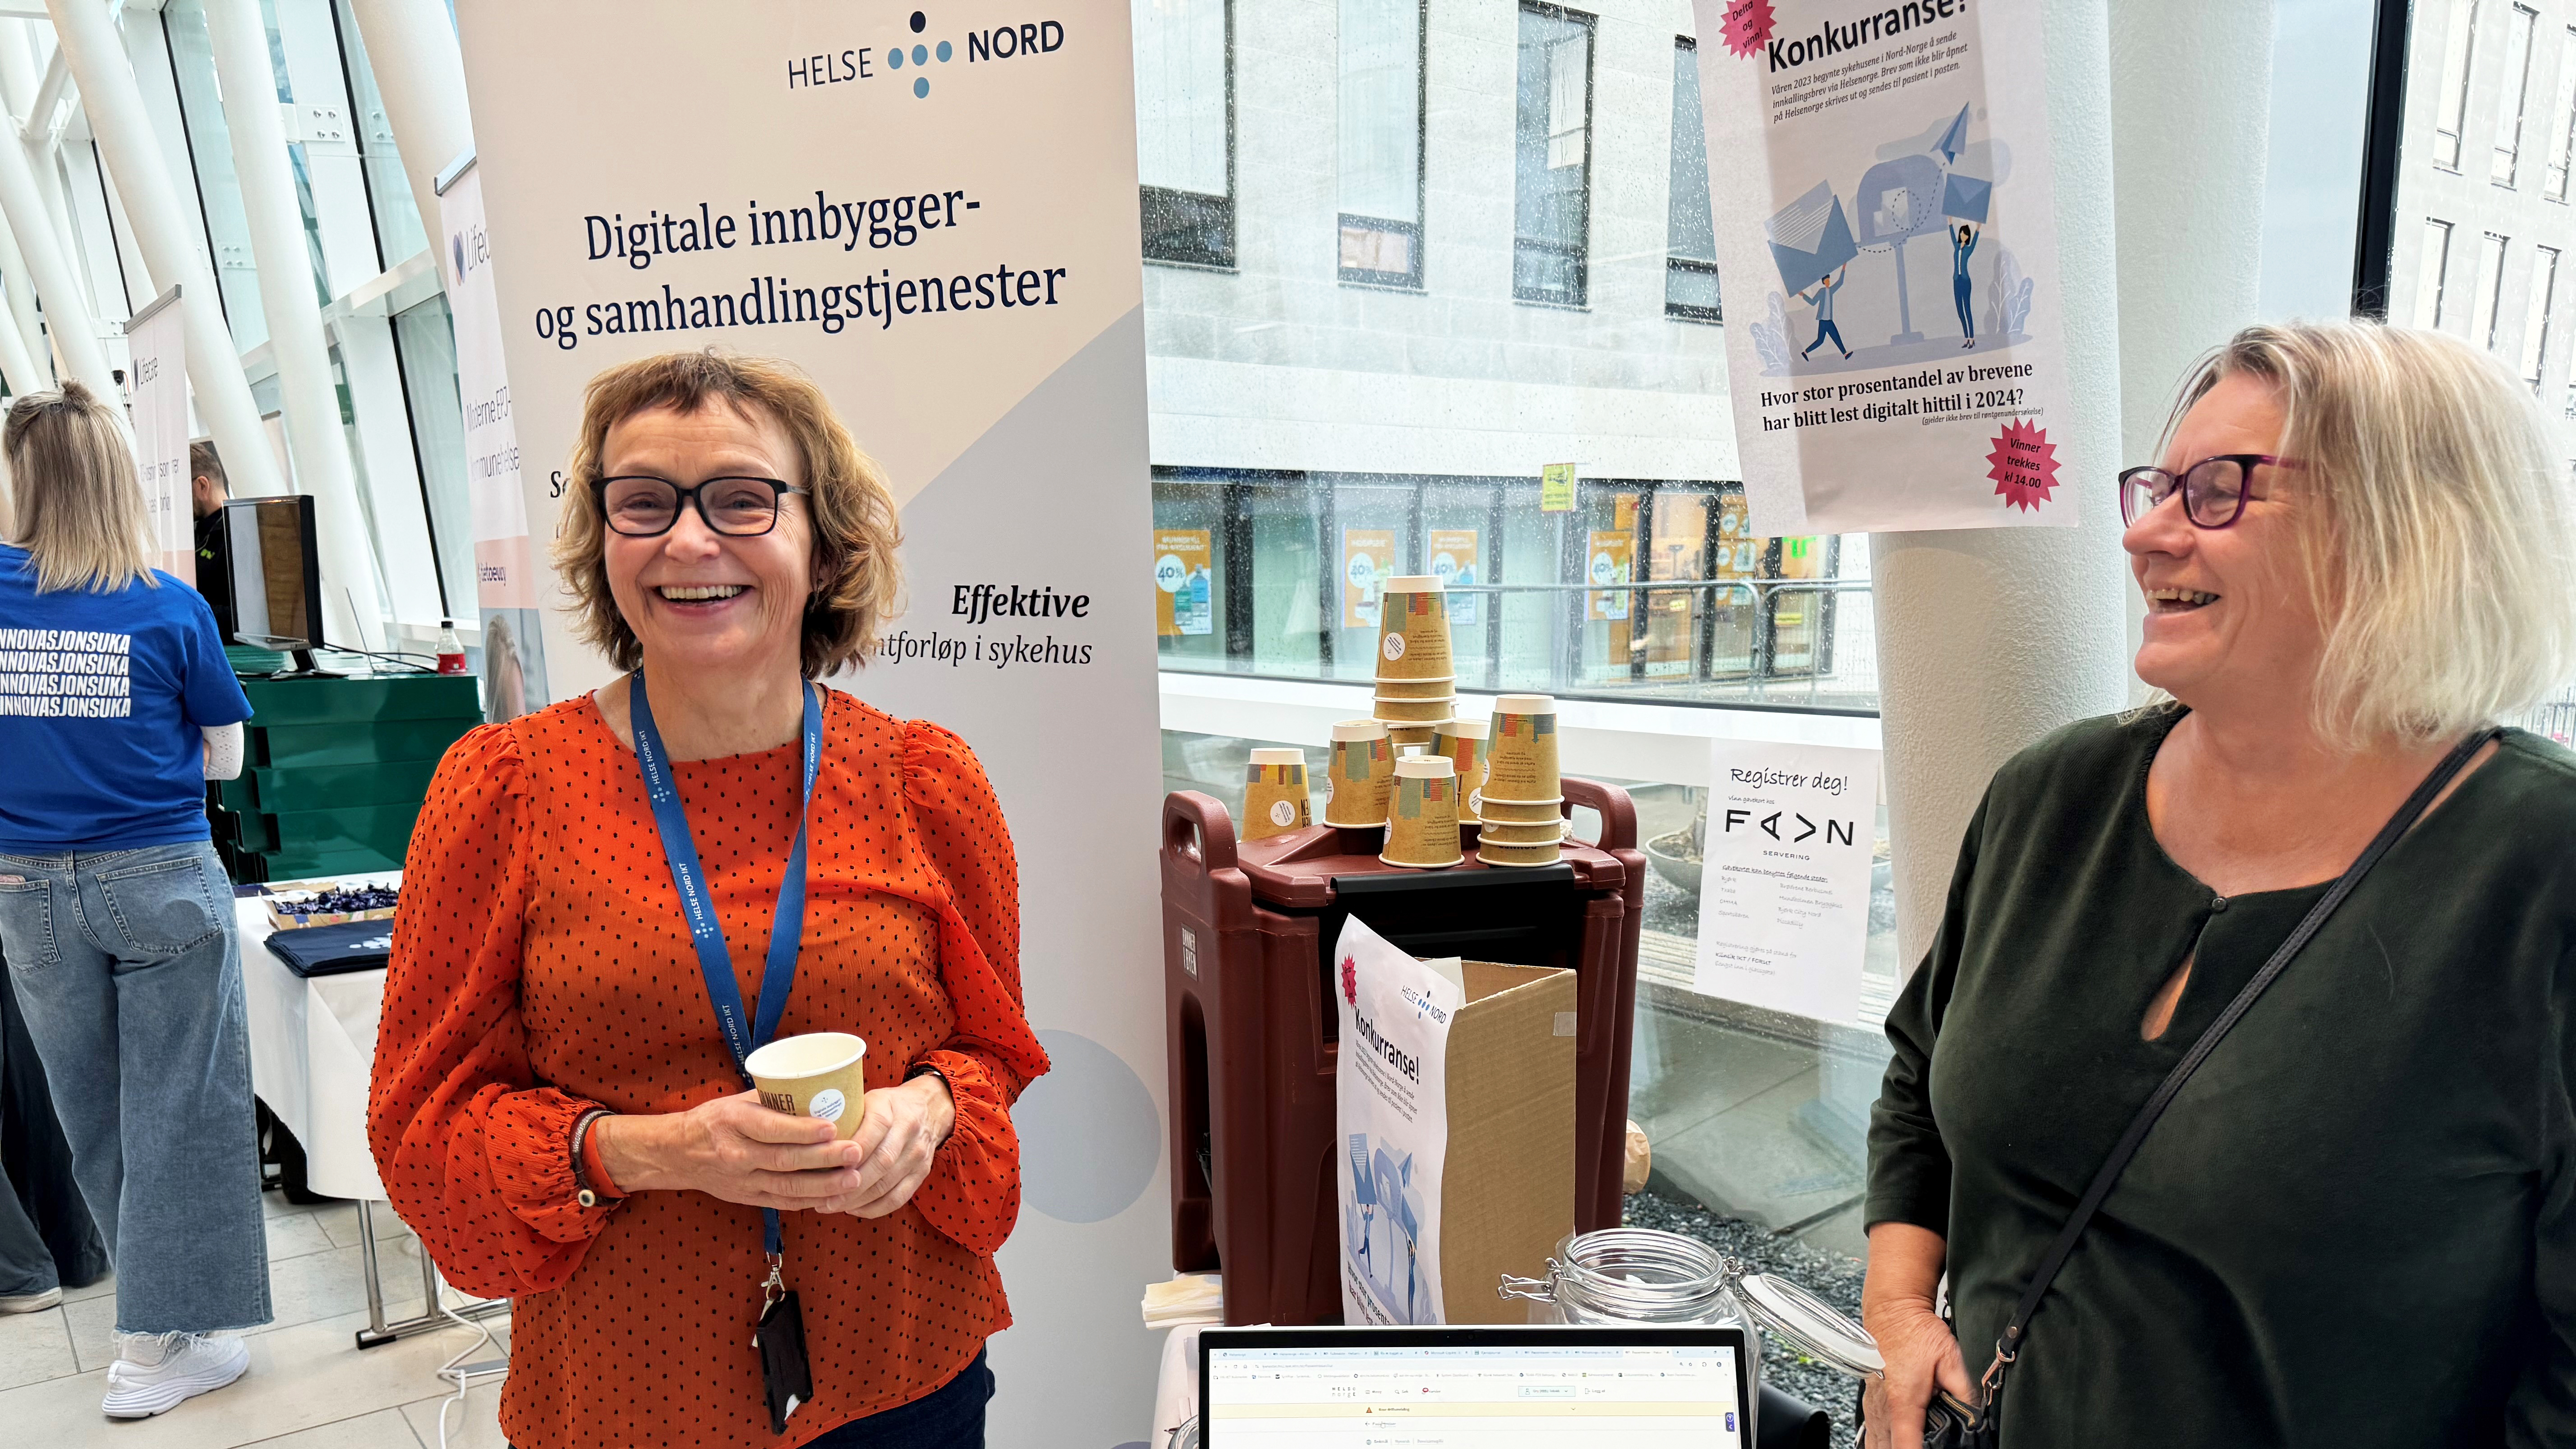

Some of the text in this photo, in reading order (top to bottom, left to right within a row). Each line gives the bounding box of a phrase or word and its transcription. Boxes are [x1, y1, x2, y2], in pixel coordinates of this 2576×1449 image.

[1732, 0, 1753, 21] Delta
[1742, 19, 1753, 32] og
[788, 20, 1065, 89] HELSE NORD
[1743, 28, 1763, 49] vinn!
[1768, 0, 1965, 73] Konkurranse
[1771, 83, 1792, 95] Våren
[1794, 76, 1812, 89] 2023
[1813, 69, 1840, 83] begynte
[1841, 59, 1880, 79] sykehusene
[1886, 41, 1928, 61] Nord-Norge
[1929, 37, 1934, 47] å
[1936, 31, 1957, 46] sende
[1773, 87, 1826, 109] innkallingsbrev
[1827, 83, 1838, 93] via
[1881, 65, 1897, 78] Brev
[1898, 61, 1913, 72] som
[1915, 55, 1930, 67] ikke
[1932, 50, 1945, 62] blir
[1946, 43, 1968, 59] åpnet
[1773, 111, 1783, 124] på
[1785, 102, 1824, 120] Helsenorge
[1825, 94, 1849, 108] skrives
[1849, 92, 1858, 100] ut
[1858, 90, 1867, 99] og
[1868, 81, 1894, 95] sendes
[1902, 70, 1928, 87] pasient
[1934, 62, 1960, 78] posten.
[584, 190, 980, 270] Digitale innbygger-
[535, 264, 1066, 350] og samhandlingstjenester
[1761, 363, 2033, 407] Hvor stor prosentandel av brevene
[1762, 388, 2024, 431] har blitt lest digitalt hittil i 2024?
[1922, 416, 1945, 426] (gjelder
[1946, 414, 1958, 422] ikke
[1959, 412, 1973, 421] brev
[1982, 407, 2043, 420] røntgenundersøkelse)
[470, 442, 520, 482] mmunehelse
[2007, 455, 2041, 471] trekkes
[2010, 437, 2041, 453] Vinner
[2004, 471, 2041, 488] kl 14.00
[1158, 567, 1185, 582] 40%
[951, 584, 1090, 625] Effektive
[975, 635, 981, 661] i
[989, 635, 1092, 669] sykehus
[639, 730, 660, 785] HELSE NORD IKT
[1730, 767, 1848, 796] Registrer deg!
[1763, 850, 1810, 861] SERVERING
[678, 862, 704, 920] HELSE NORD IKT
[722, 1005, 732, 1017] IKT
[1400, 985, 1447, 1024] HELSE NORD
[727, 1017, 739, 1040] NORD
[1355, 1005, 1419, 1085] Konkurranse!
